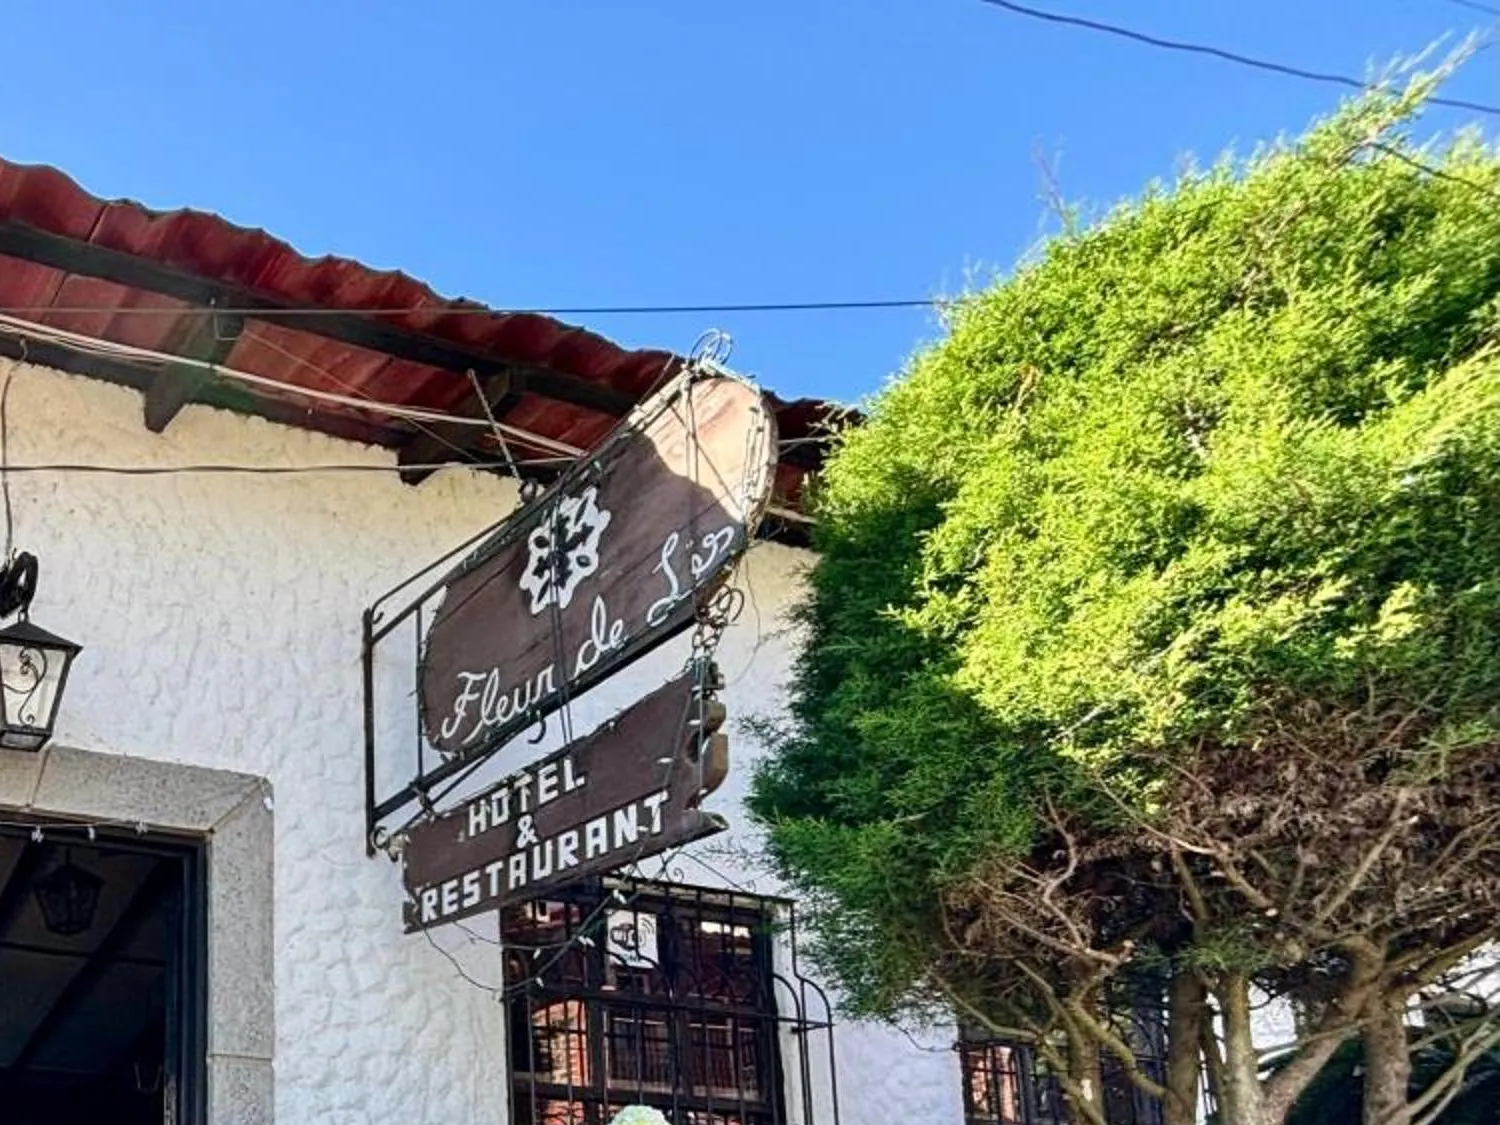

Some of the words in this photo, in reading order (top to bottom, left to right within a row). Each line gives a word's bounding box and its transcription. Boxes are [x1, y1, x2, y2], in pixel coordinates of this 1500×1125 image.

[441, 663, 557, 746] Fleur
[573, 594, 628, 680] de
[467, 758, 585, 837] HOTEL
[516, 815, 537, 849] &
[421, 790, 669, 924] RESTAURANT
